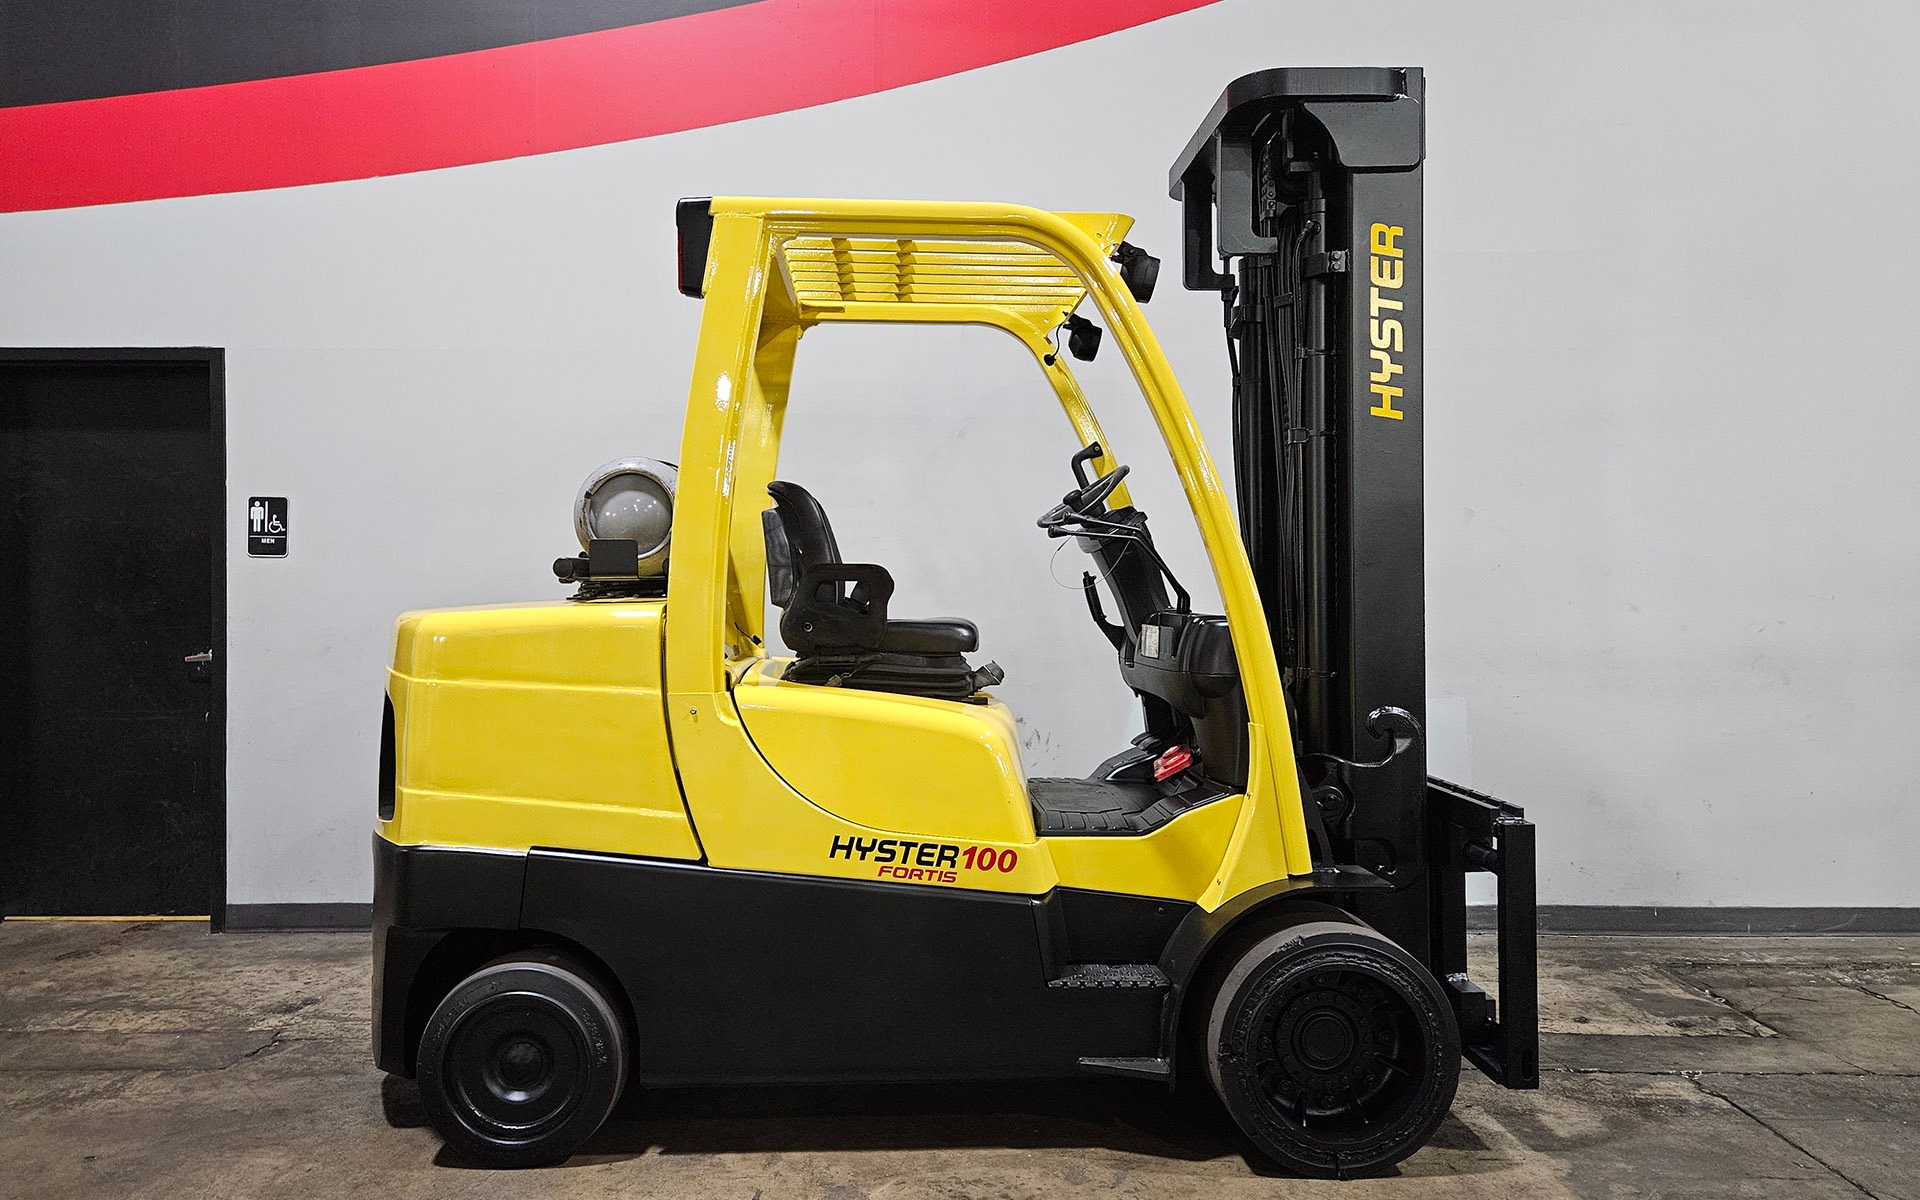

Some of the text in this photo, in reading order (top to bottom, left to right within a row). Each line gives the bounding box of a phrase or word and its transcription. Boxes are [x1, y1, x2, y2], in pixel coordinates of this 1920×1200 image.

[1370, 222, 1403, 420] HYSTER
[829, 835, 1018, 873] HYSTER 100
[877, 866, 958, 883] FORTIS
